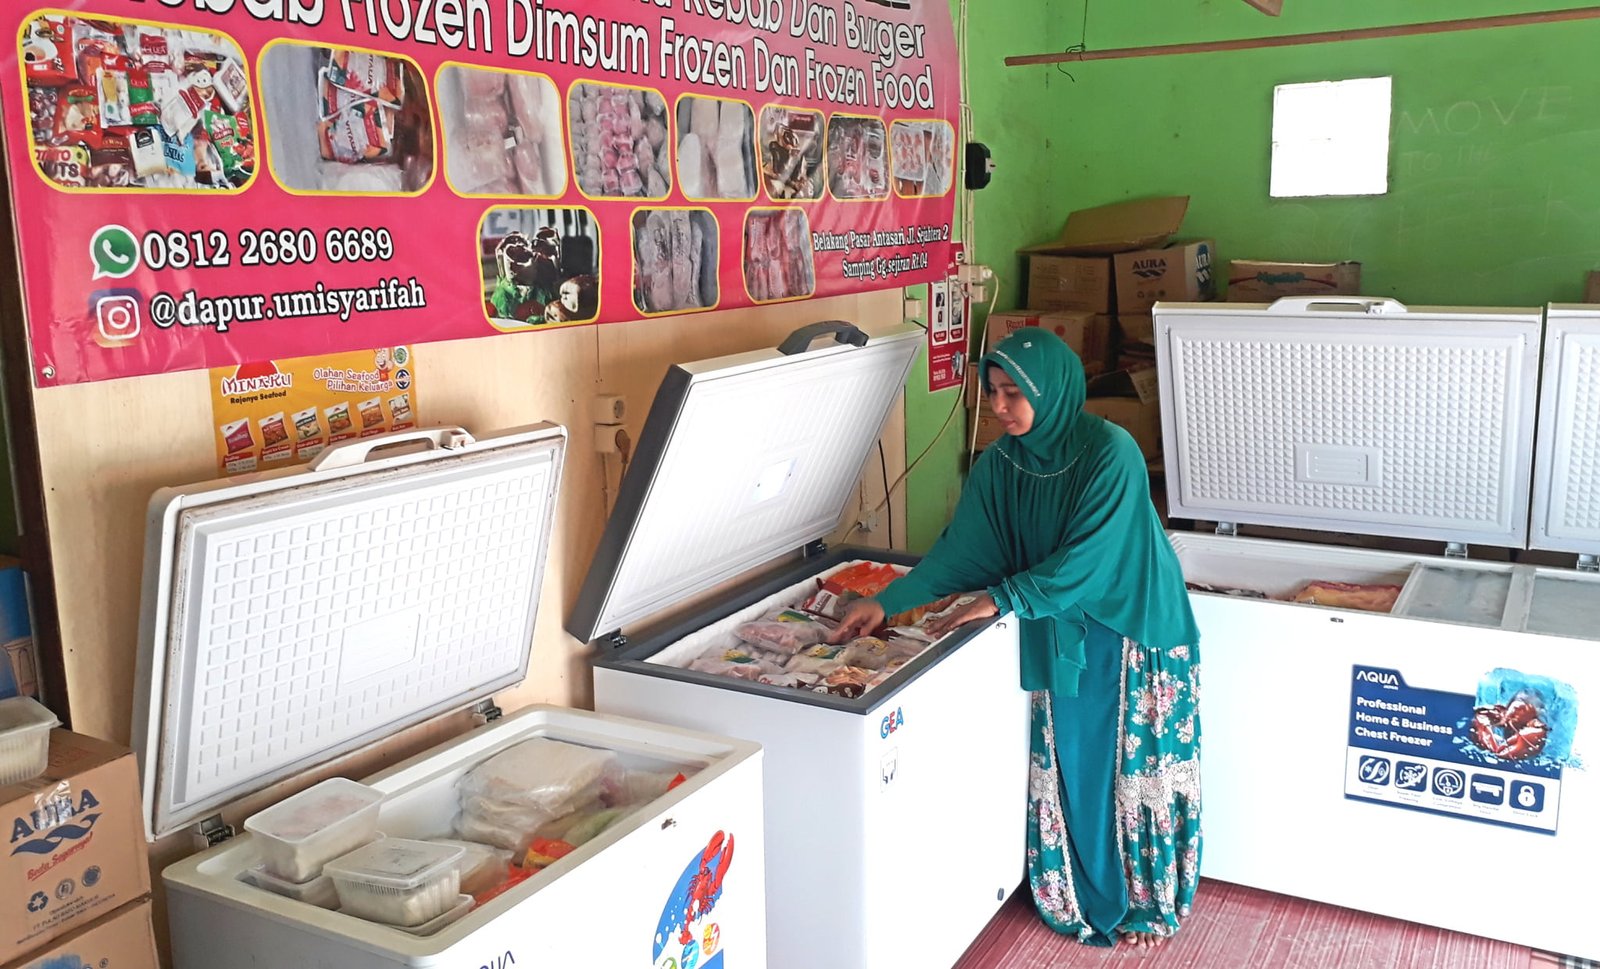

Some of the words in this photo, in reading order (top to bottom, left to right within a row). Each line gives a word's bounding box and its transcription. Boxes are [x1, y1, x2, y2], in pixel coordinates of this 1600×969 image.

[682, 0, 785, 33] ebab
[789, 0, 838, 46] Dan
[843, 1, 926, 67] Burger
[506, 0, 649, 76] Dimsum
[660, 16, 747, 90] Frozen
[752, 37, 800, 98] Dan
[805, 47, 868, 106] Frozen
[871, 61, 935, 109] Food
[142, 230, 230, 269] 0812
[239, 228, 317, 265] 2680
[325, 227, 394, 262] 6689
[812, 231, 849, 254] Belakang
[850, 231, 871, 248] Pasar
[872, 228, 905, 247] Antasari
[942, 223, 950, 240] 2
[842, 258, 876, 279] Samping
[1132, 258, 1167, 270] AURA
[150, 277, 426, 332] @dapur.umisyarifah
[221, 373, 292, 396] MINAKU
[313, 368, 344, 379] Olahan
[346, 368, 379, 381] Seafood
[327, 380, 356, 391] Pilihan
[358, 381, 393, 391] Keluarga
[260, 390, 287, 400] Seafood
[1356, 670, 1399, 686] AQUA
[1357, 696, 1426, 715] Professional
[880, 707, 904, 739] GEA
[1355, 711, 1389, 725] Home
[1391, 717, 1400, 727] &
[1401, 718, 1453, 735] Business
[1355, 726, 1388, 740] Chest
[1390, 731, 1433, 747] Freezer
